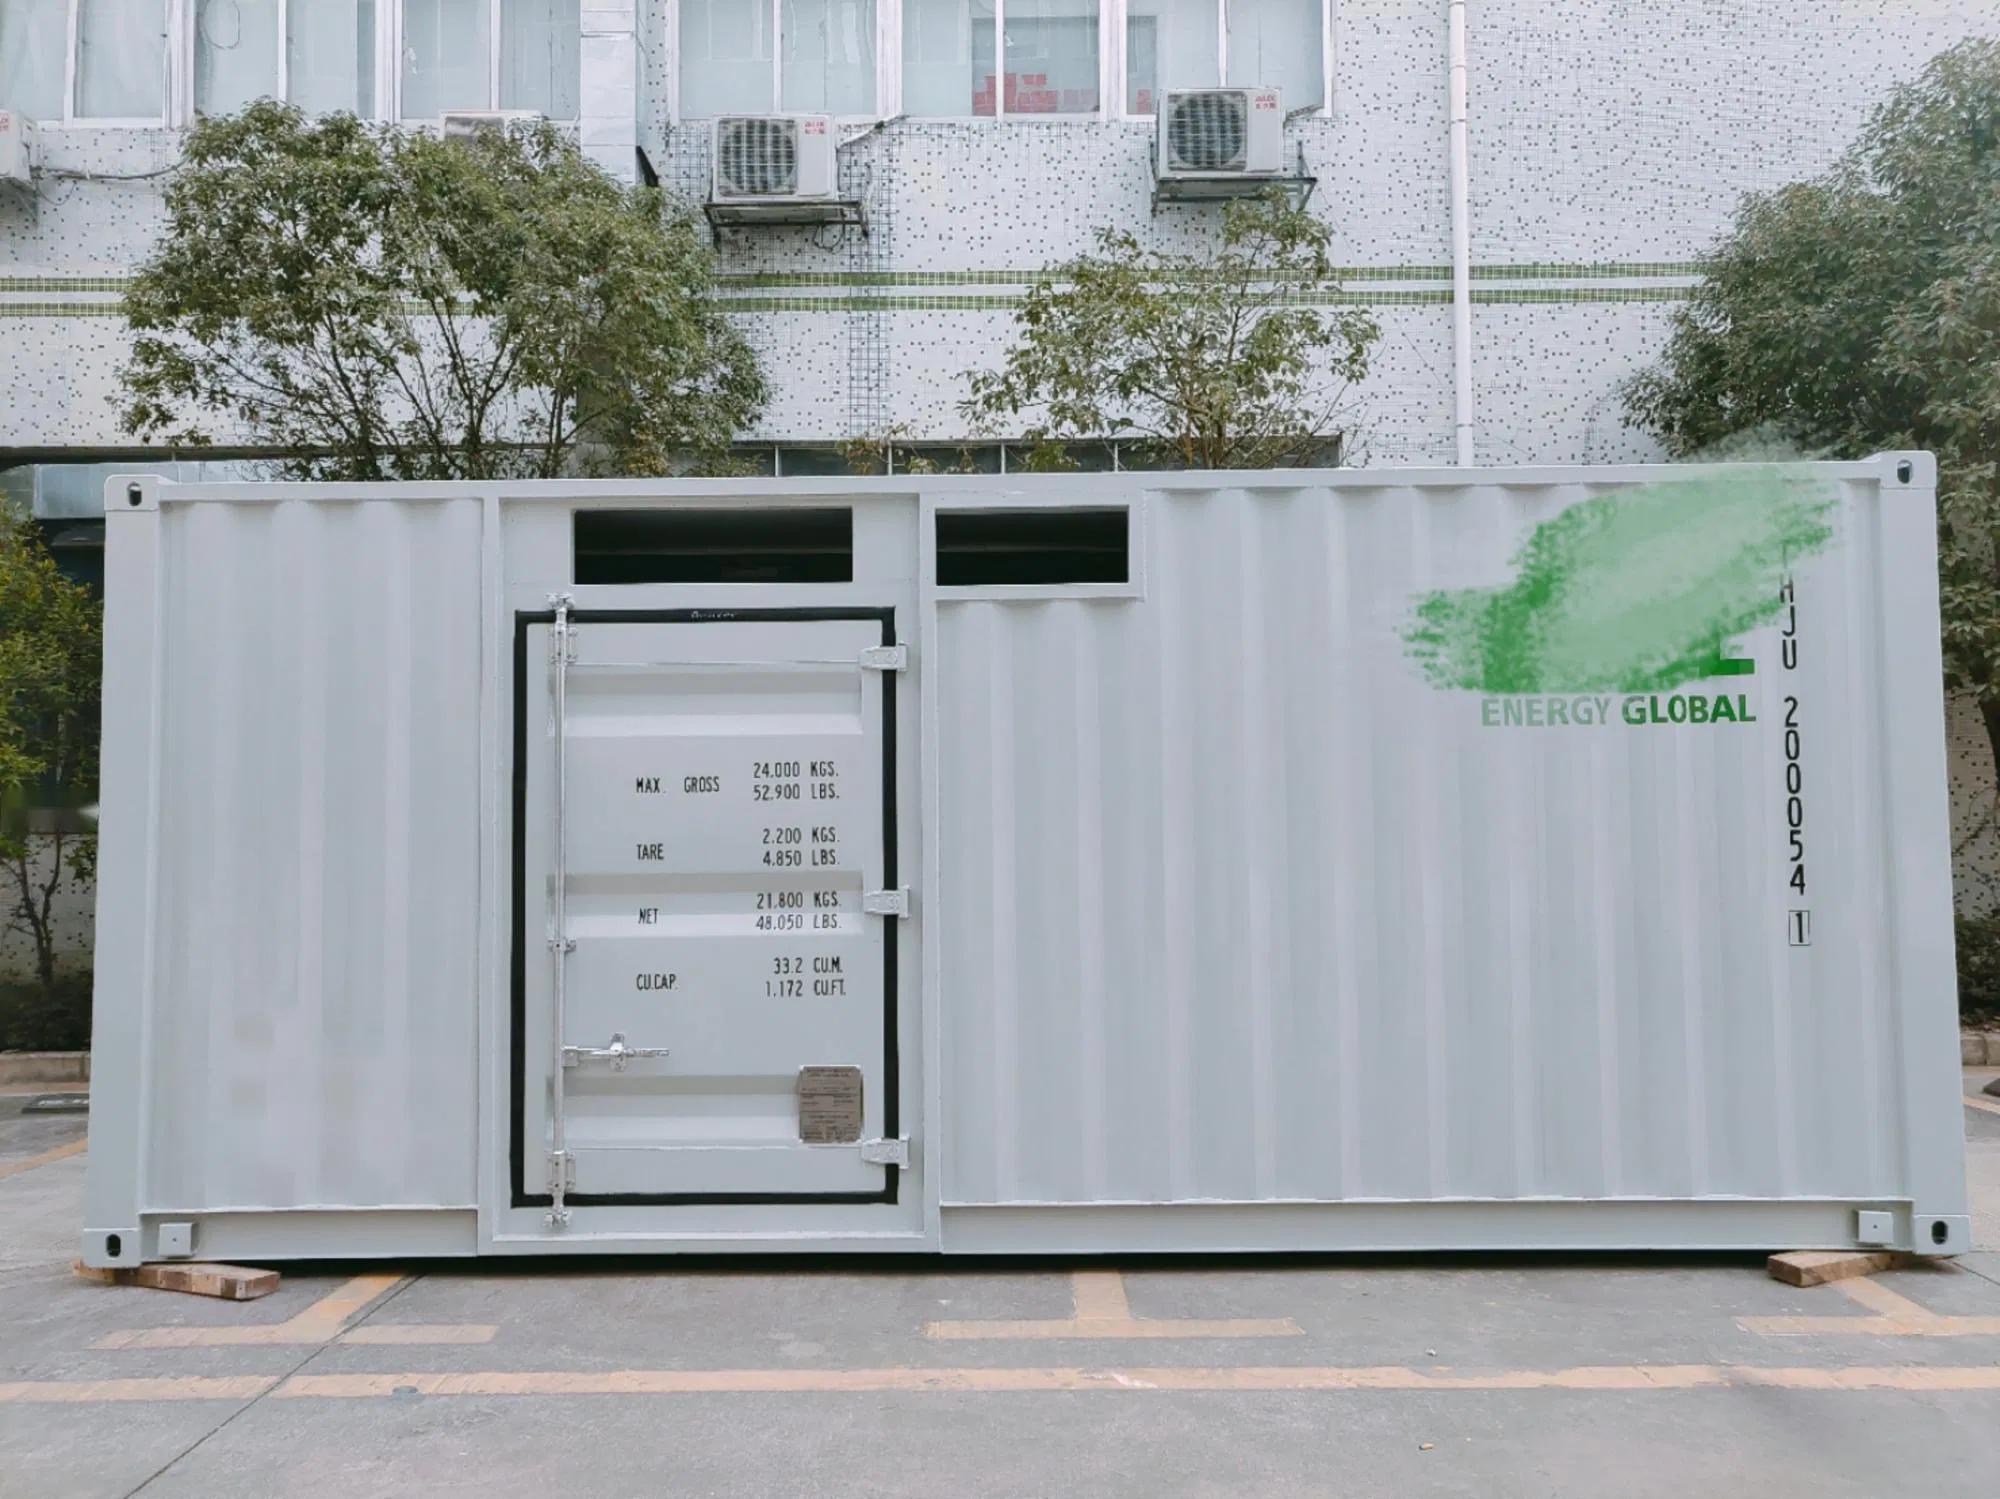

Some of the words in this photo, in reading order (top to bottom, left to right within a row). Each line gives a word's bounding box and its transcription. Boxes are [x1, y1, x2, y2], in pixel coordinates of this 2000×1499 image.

[1481, 695, 1612, 727] ENERGY
[1621, 694, 1757, 725] GLOBAL
[684, 776, 720, 793] GROSS
[1784, 696, 1806, 896] 200054
[637, 843, 664, 860] TARE
[638, 908, 659, 924] NET
[773, 957, 803, 974] 33.2
